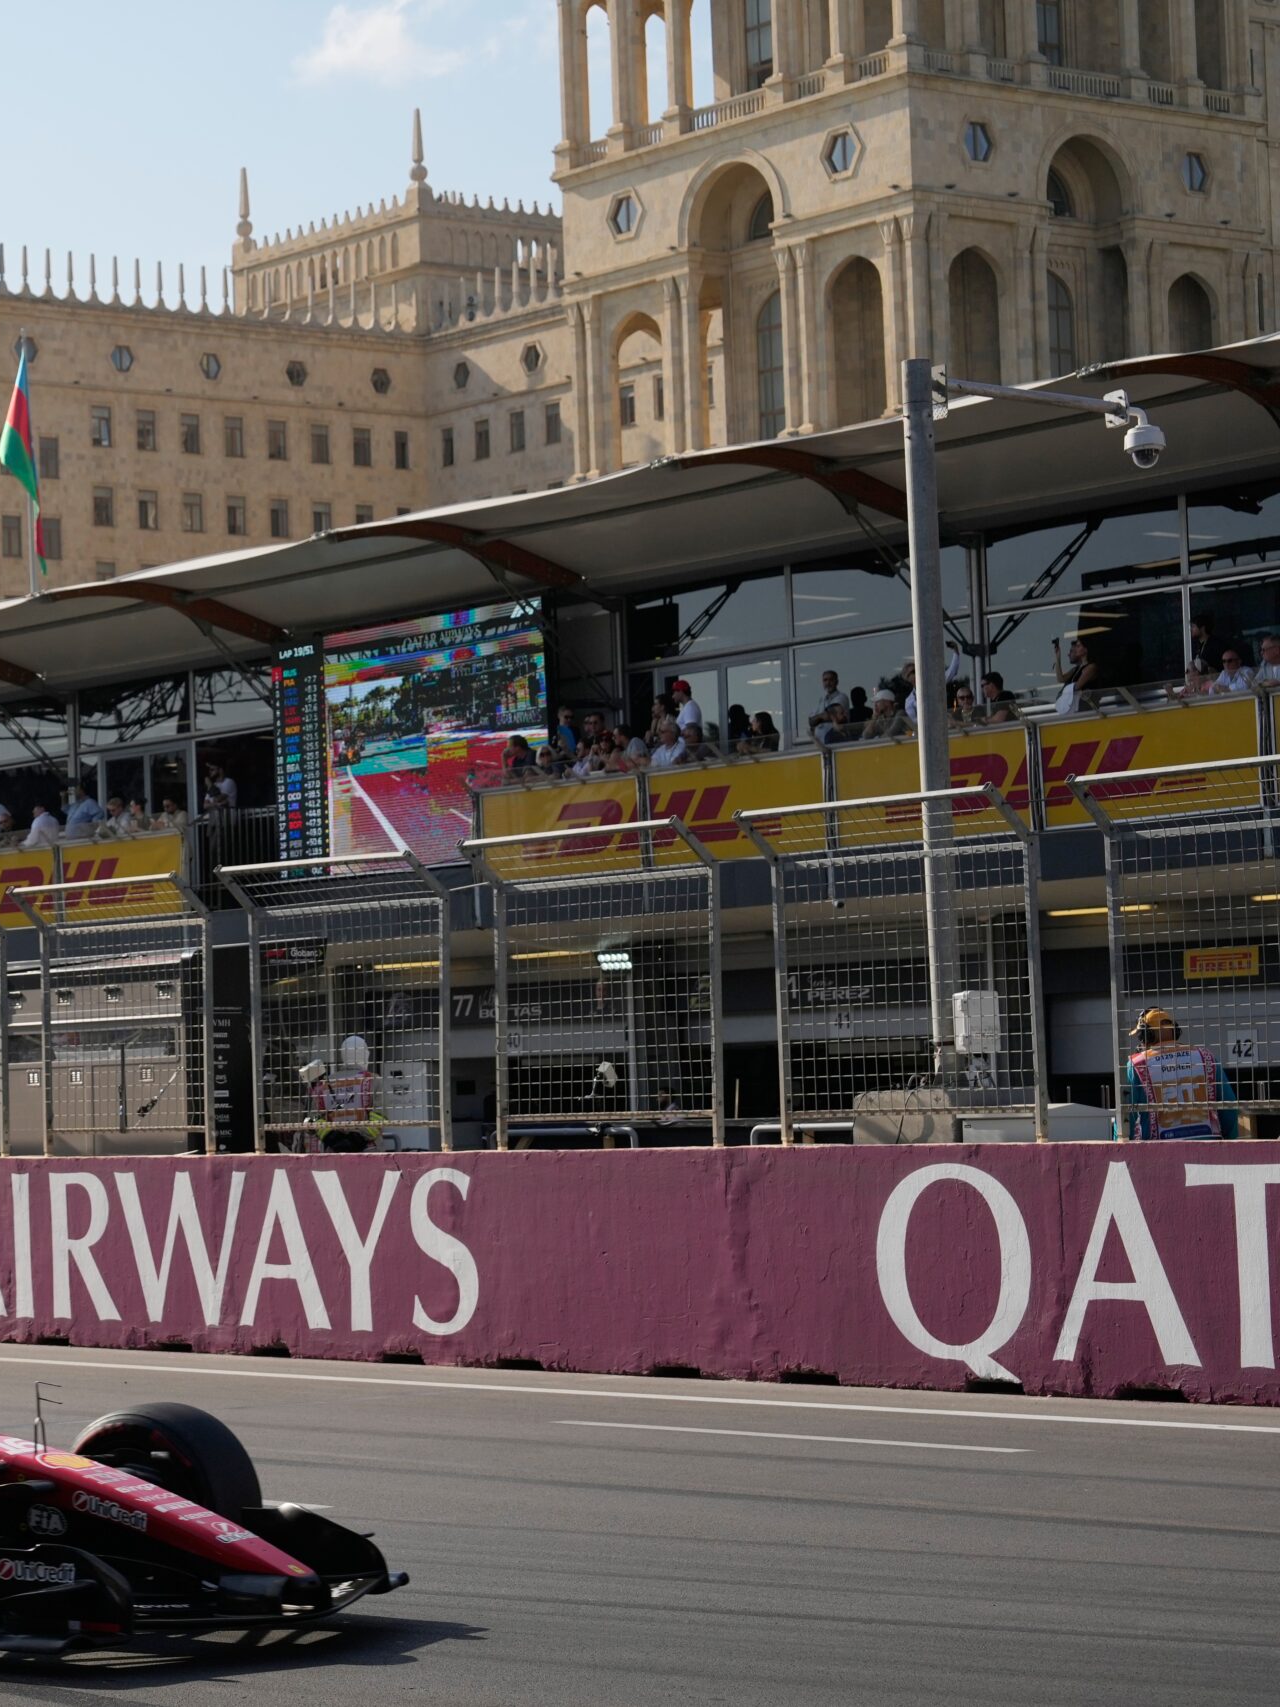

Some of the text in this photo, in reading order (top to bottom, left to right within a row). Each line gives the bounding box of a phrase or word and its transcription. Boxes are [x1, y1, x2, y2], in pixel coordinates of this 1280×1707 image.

[279, 645, 314, 660] LAP 19/51
[287, 763, 300, 773] BEA
[949, 735, 1158, 817] DHL
[288, 792, 302, 801] OCO
[556, 785, 741, 857] DHL
[290, 946, 318, 957] Globant
[1189, 951, 1252, 972] PIRELLI
[807, 988, 871, 1001] PEREZ
[453, 994, 474, 1017] 77
[479, 1006, 542, 1019] BOTAS
[834, 1012, 850, 1029] 41
[506, 1032, 520, 1048] 40
[1232, 1039, 1254, 1057] 42
[876, 1160, 1280, 1383] QAT
[88, 1495, 148, 1533] UniCredit
[14, 1558, 76, 1584] UniCredit
